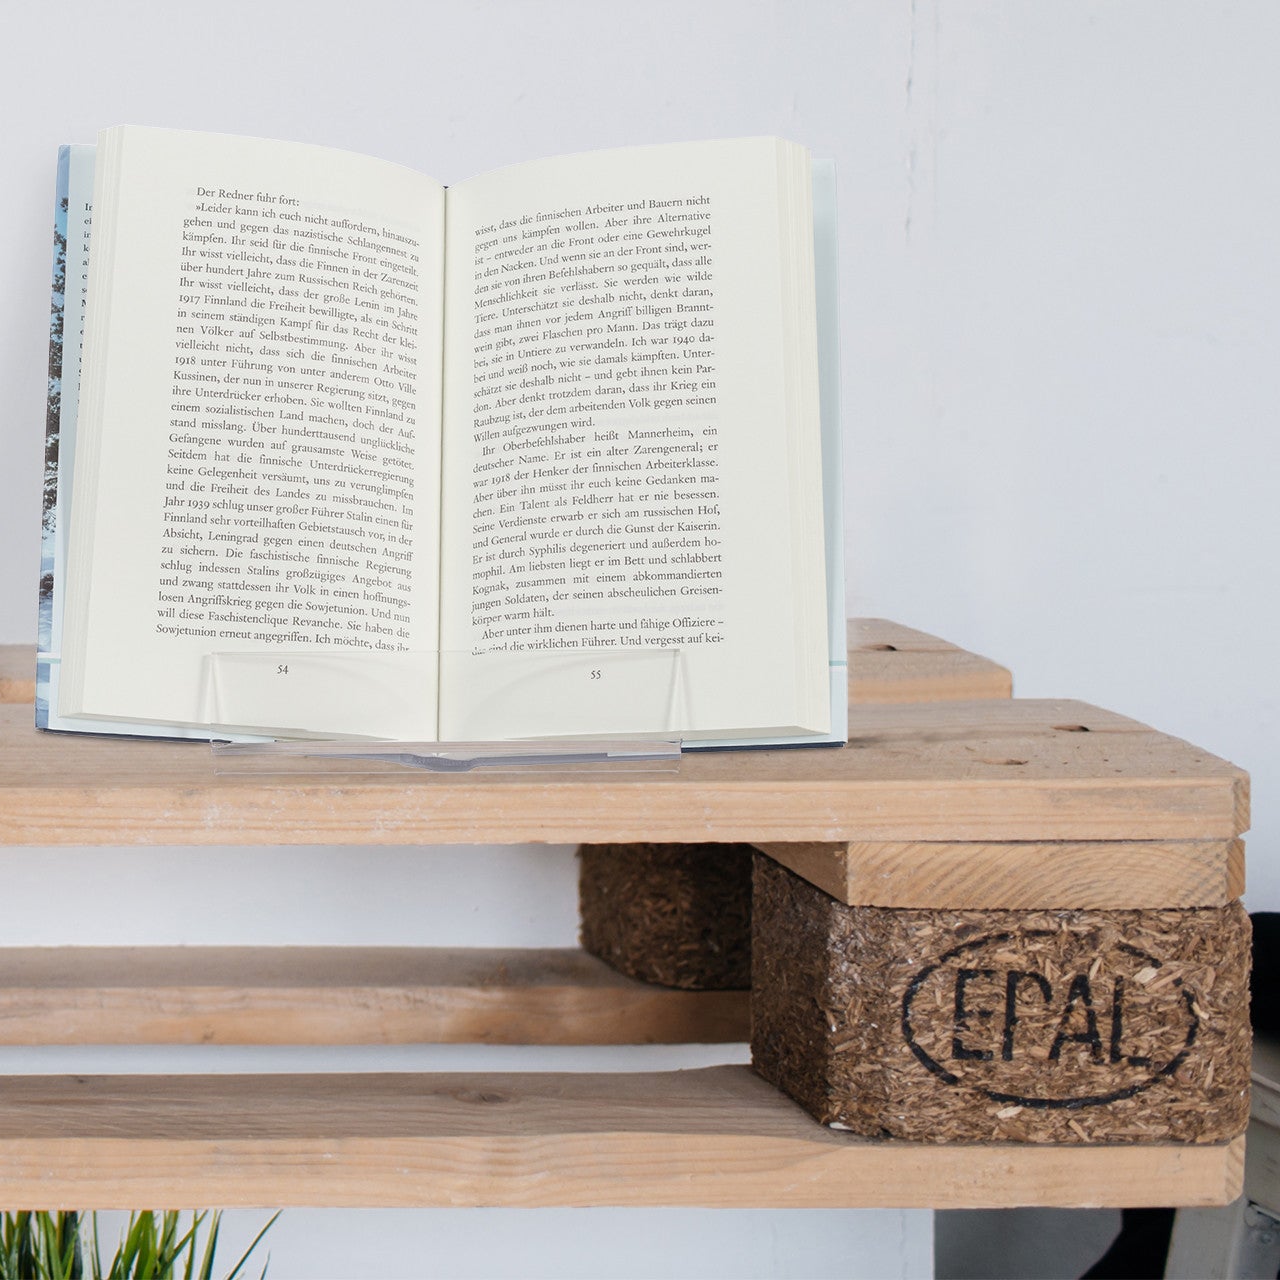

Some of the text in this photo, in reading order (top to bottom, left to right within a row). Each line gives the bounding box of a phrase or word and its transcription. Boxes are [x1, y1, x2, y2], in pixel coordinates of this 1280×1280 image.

[196, 186, 299, 206] Der Redner fuhr fort:
[498, 219, 517, 230] dass
[519, 214, 533, 225] die
[535, 207, 582, 222] finnischen
[584, 202, 624, 215] Arbeiter
[626, 199, 645, 210] und
[648, 199, 682, 208] Bauern
[685, 194, 710, 206] nicht
[195, 202, 232, 214] »Leider
[234, 204, 258, 216] kann
[261, 207, 276, 218] ich
[278, 211, 301, 221] euch
[304, 213, 328, 225] nicht
[330, 218, 380, 237] auffordern,
[182, 230, 227, 245] kämpfen.
[231, 234, 246, 246] Ihr
[249, 237, 268, 248] seid
[272, 238, 286, 250] für
[289, 241, 304, 253] die
[307, 243, 349, 259] finnische
[352, 251, 377, 265] Front
[474, 241, 711, 280] in den Nacken. Und wenn sie an der Front sind, wer-
[179, 276, 418, 321] Ihr wisst vielleicht, dass der große Lenin im Jahre
[501, 300, 558, 317] Unterschätzt
[561, 297, 574, 307] sie
[578, 292, 615, 306] deshalb
[618, 290, 646, 302] nicht,
[649, 287, 679, 299] denkt
[681, 286, 713, 297] daran,
[177, 307, 186, 318] in
[190, 309, 224, 321] seinem
[228, 312, 275, 327] ständigen
[279, 316, 313, 331] Kampf
[315, 320, 329, 331] für
[332, 323, 349, 334] das
[352, 326, 378, 340] Recht
[381, 332, 397, 344] der
[473, 317, 714, 353] wein gibt, zwei Flaschen pro Mann. Das trägt dazu
[175, 355, 416, 395] 1918 unter Führung von unter anderem Otto Ville
[473, 394, 716, 428] Raubzug ist, der dem arbeitenden Volk gegen seinen
[168, 432, 221, 448] Gefangene
[227, 437, 264, 449] wurden
[270, 439, 287, 450] auf
[291, 444, 345, 456] grausamste
[350, 448, 377, 461] Weise
[481, 425, 717, 456] Ihr Oberbefehlshaber heißt Mannerheim, ein
[472, 473, 719, 504] Aber über ihn müsst ihr euch keine Gedanken ma-
[162, 495, 413, 531] Jahr 1939 schlug unser großer Führer Stalin einen für
[472, 520, 720, 549] und General wurde er durch die Gunst der Kaiserin.
[470, 584, 722, 614] jungen Soldaten, der seinen abscheulichen Greisen-
[156, 607, 410, 638] will diese Faschistenclique Revanche. Sie haben die
[277, 664, 289, 675] 54
[590, 669, 601, 680] 55
[951, 969, 1152, 1065] EPAL
